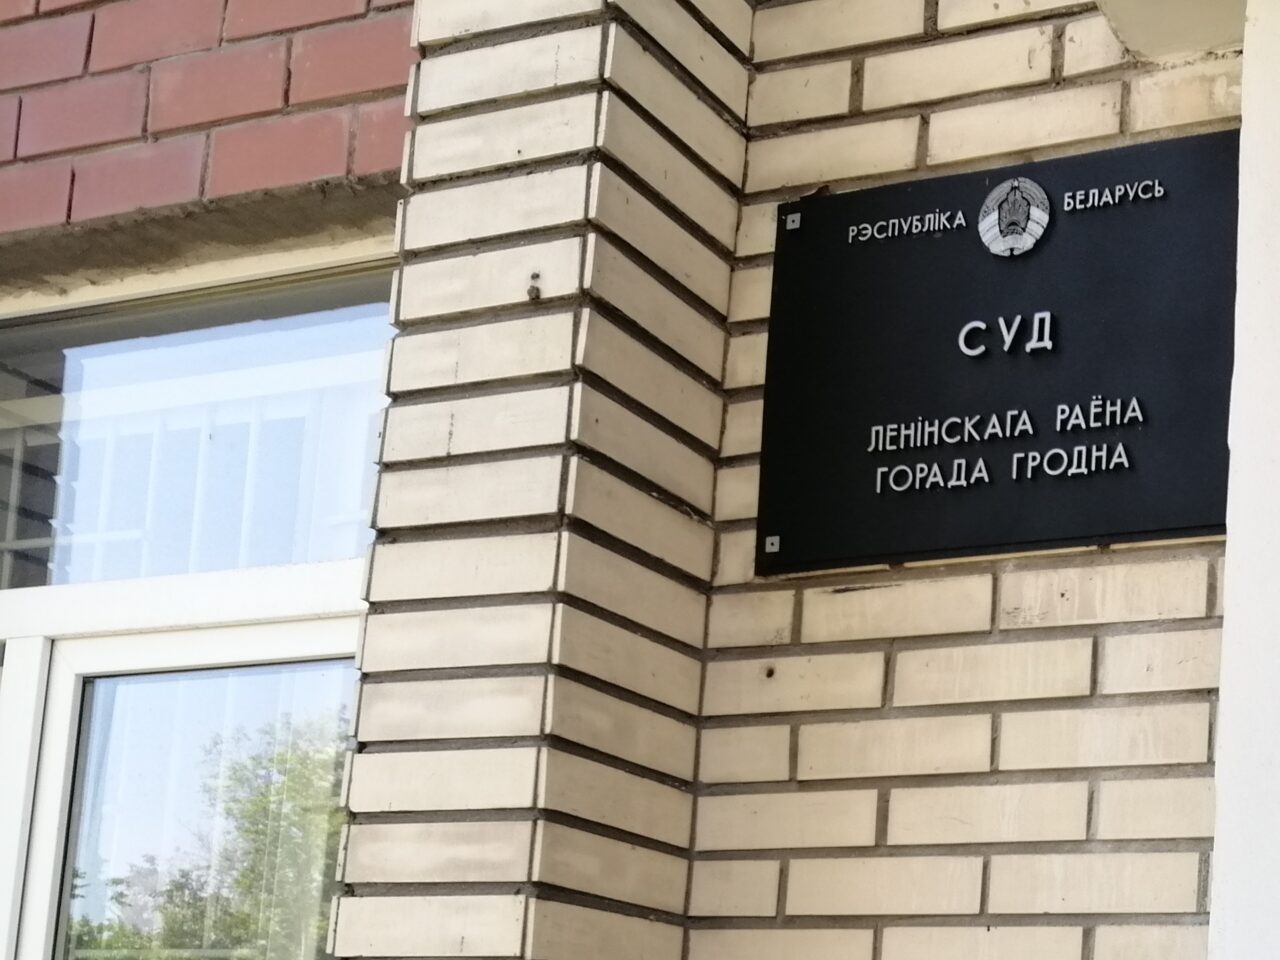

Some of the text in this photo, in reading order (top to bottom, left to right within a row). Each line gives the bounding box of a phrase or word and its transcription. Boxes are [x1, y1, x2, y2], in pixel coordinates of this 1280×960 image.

[847, 178, 1165, 244] РЭСПУБЛІКА БЕЛАРУСЬ
[957, 311, 1054, 357] СУД
[866, 394, 1145, 453] ЛЕНІНСКАГА РАЁНА
[875, 442, 1130, 494] ГОРАДА ГРОДНА
